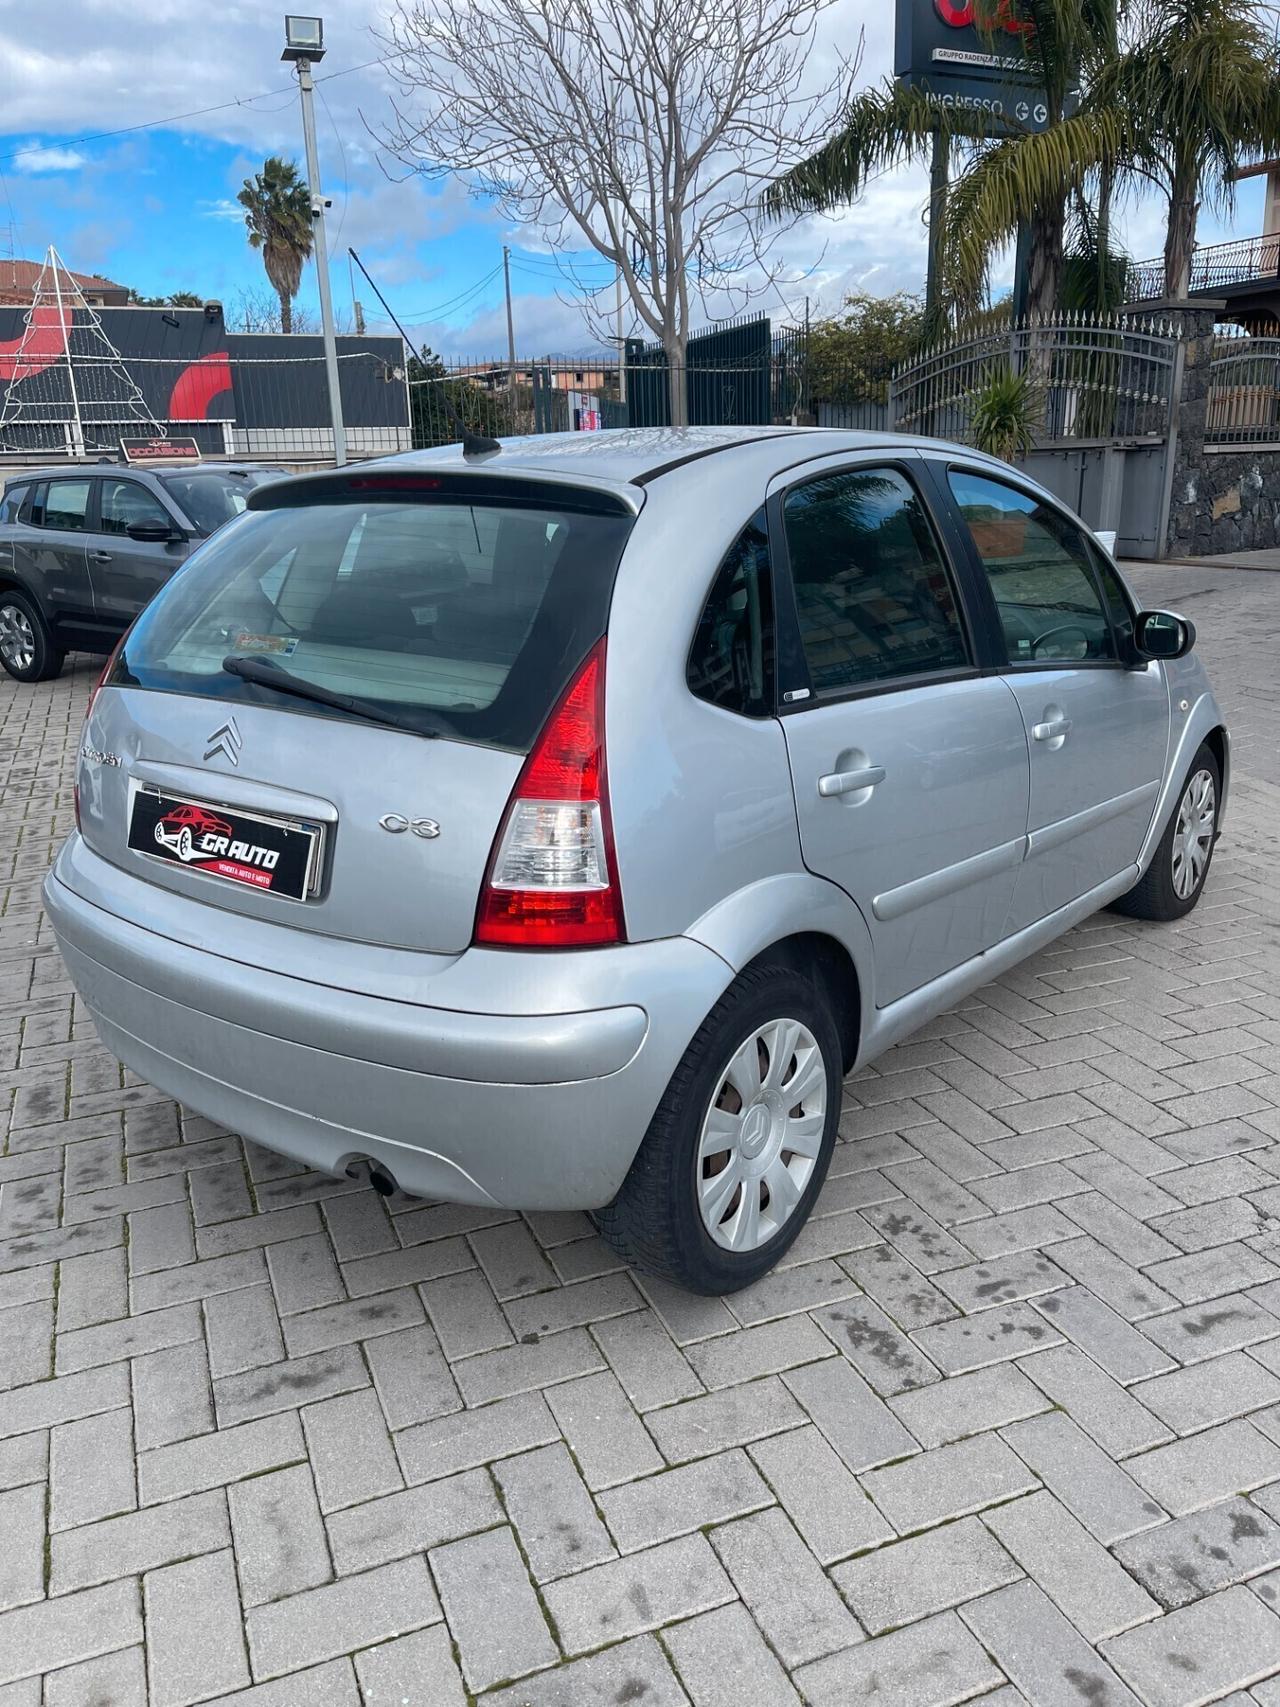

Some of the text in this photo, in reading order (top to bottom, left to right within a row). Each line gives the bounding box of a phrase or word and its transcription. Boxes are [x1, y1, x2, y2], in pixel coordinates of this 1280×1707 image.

[938, 50, 964, 60] GRUPPO
[127, 447, 197, 457] OCCASIONE
[378, 812, 441, 839] C3
[200, 832, 280, 869] GR AUTO
[238, 869, 252, 879] AUTO
